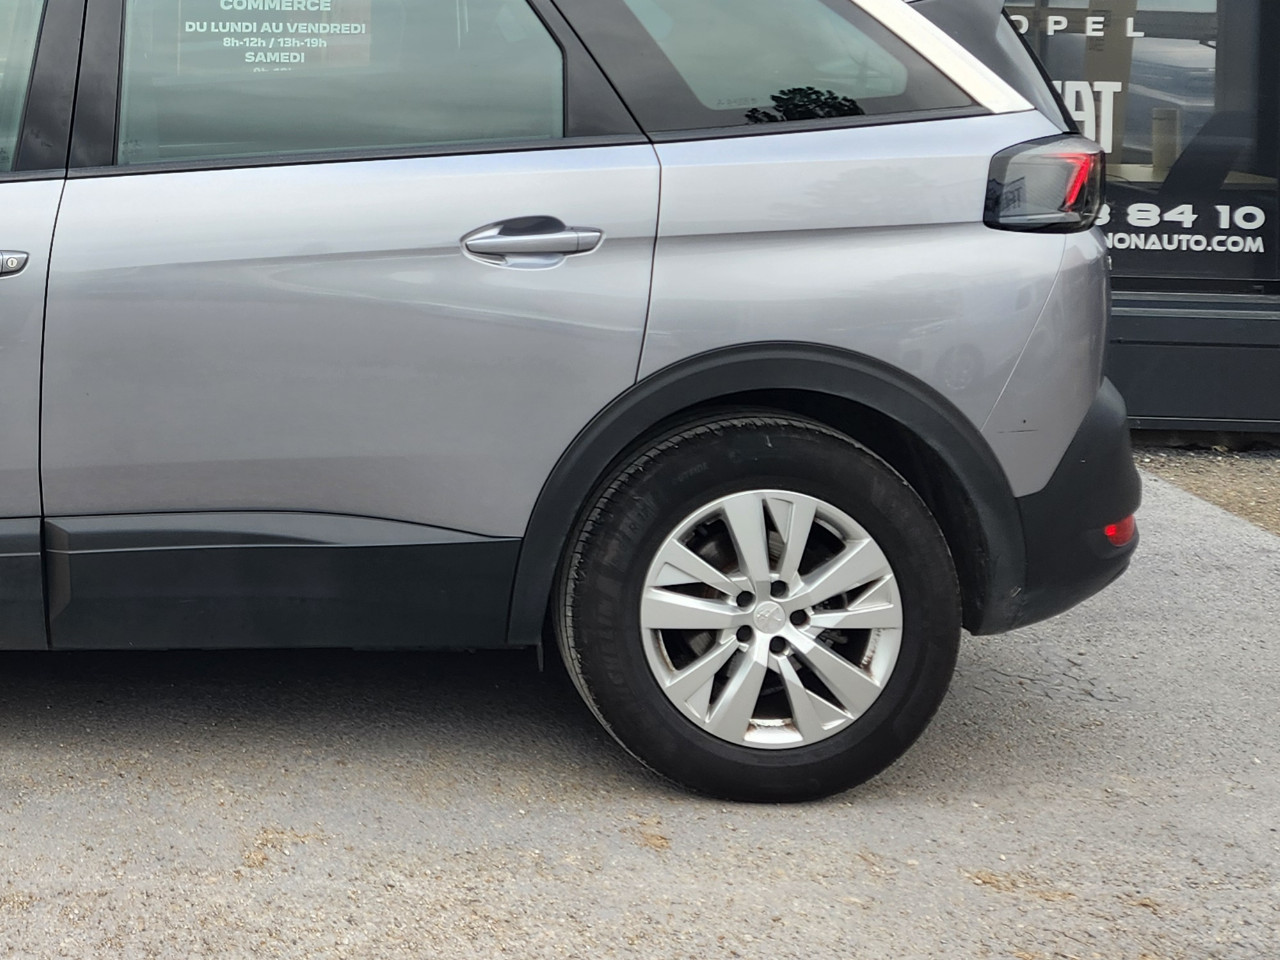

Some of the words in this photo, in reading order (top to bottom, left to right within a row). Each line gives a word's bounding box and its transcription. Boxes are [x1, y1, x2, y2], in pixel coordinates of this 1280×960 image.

[185, 21, 207, 32] DU
[211, 22, 257, 33] LUNDI
[261, 22, 283, 33] AU
[287, 23, 366, 34] VENDREDI
[223, 38, 266, 47] 8h-12h
[278, 38, 327, 47] 13h-19h
[245, 52, 305, 63] SAMEDI
[1127, 203, 1198, 228] 84
[1214, 204, 1266, 230] 10
[1105, 233, 1265, 252] NONAUTO.COM
